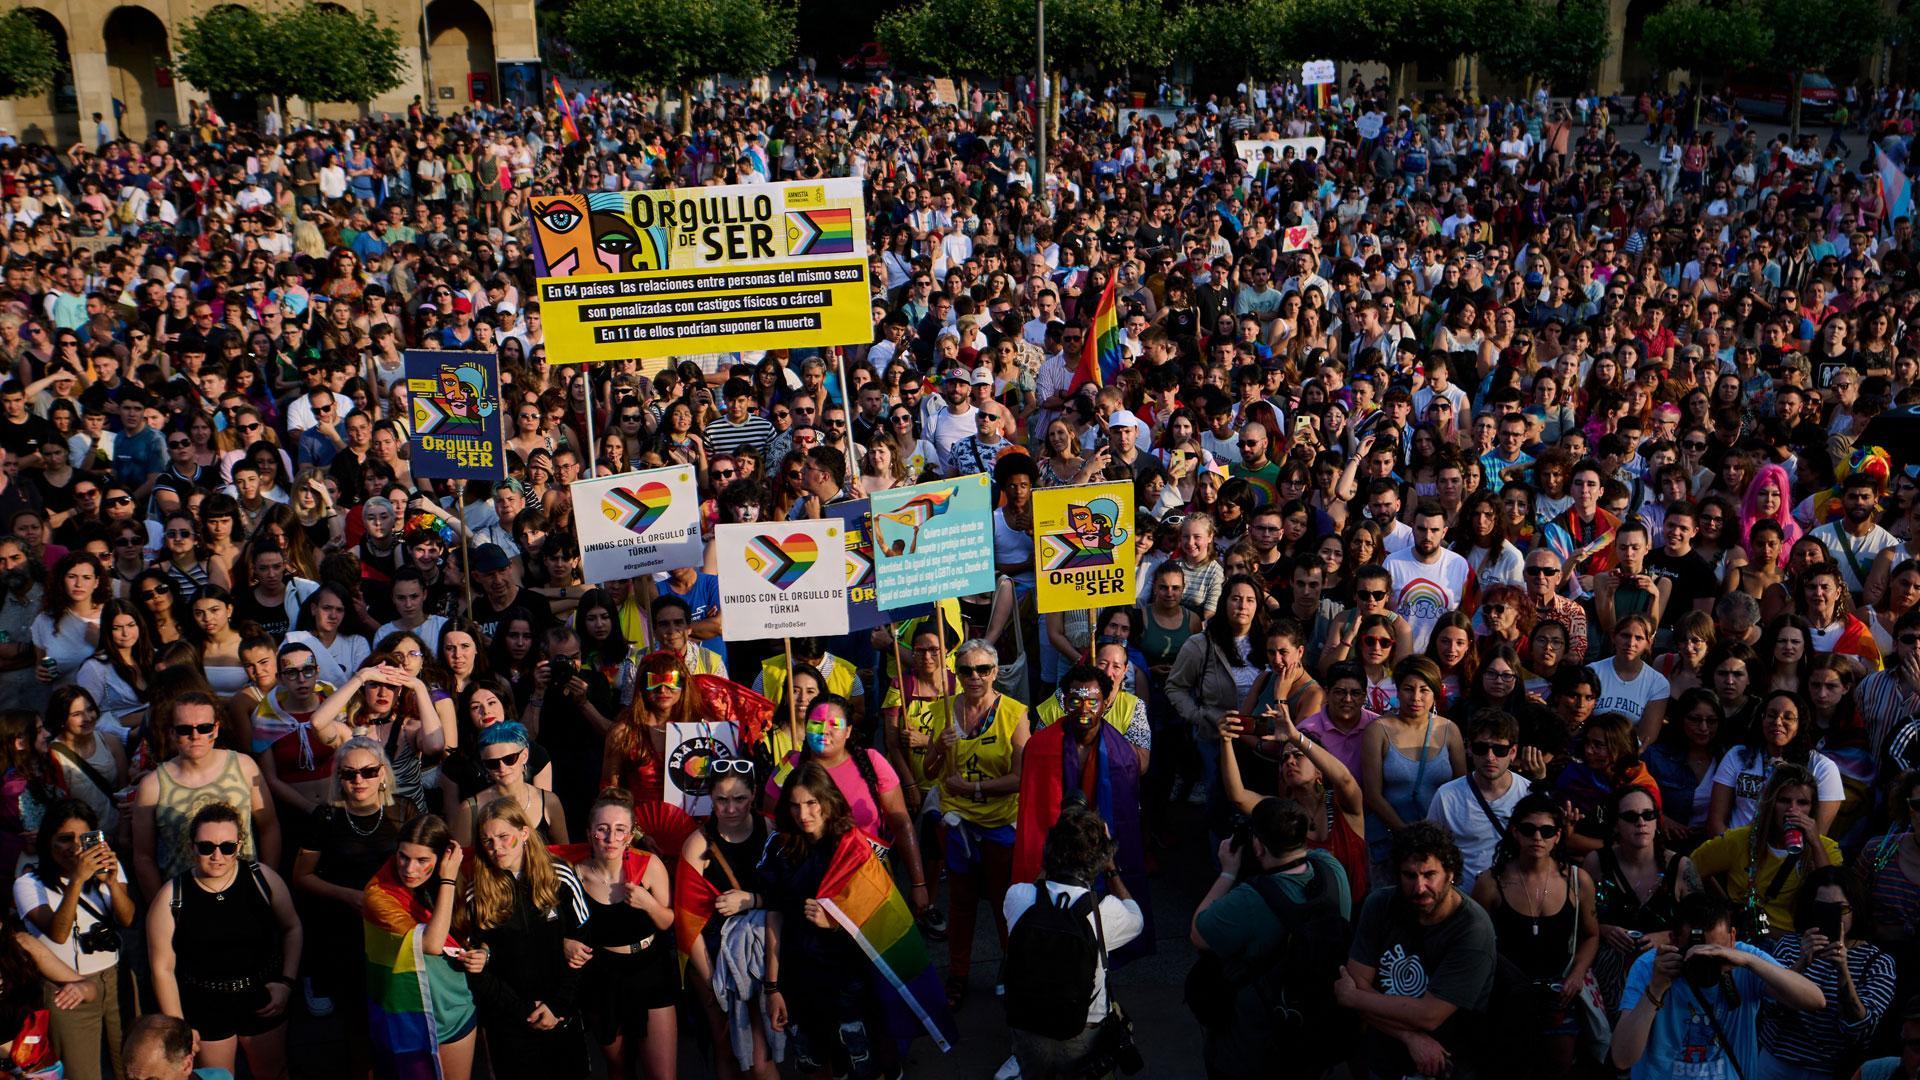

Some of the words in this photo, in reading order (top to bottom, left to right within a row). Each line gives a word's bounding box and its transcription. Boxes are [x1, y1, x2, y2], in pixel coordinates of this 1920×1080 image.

[678, 232, 697, 247] DE
[703, 223, 776, 261] SER
[548, 286, 561, 298] En
[564, 284, 578, 297] 64
[580, 283, 615, 299] países
[620, 281, 636, 293] las
[638, 278, 694, 292] relaciones
[696, 276, 724, 288] entre
[728, 274, 776, 288] personas
[778, 271, 794, 283] del
[797, 270, 832, 282] mismo
[834, 269, 858, 280] sexo
[588, 308, 606, 318] son
[610, 302, 672, 319] penalizadas
[674, 301, 694, 312] con
[697, 297, 742, 312] castigos
[743, 295, 778, 309] físicos
[780, 296, 787, 306] o
[790, 292, 824, 305] cárcel
[602, 328, 615, 340] En
[618, 327, 630, 339] 11
[633, 326, 646, 338] de
[650, 325, 674, 338] ellos
[678, 322, 717, 338] podrían
[720, 320, 762, 334] suponer
[764, 318, 774, 330] la
[776, 316, 814, 328] muerte
[456, 452, 494, 467] SER
[584, 541, 615, 552] UNIDOS
[617, 538, 634, 548] CON
[648, 530, 684, 542] ORGULLO
[687, 526, 697, 536] DE
[628, 545, 657, 556] TÜRKIA
[624, 559, 664, 570] #OrgulloDeSer
[1086, 580, 1124, 596] SER
[724, 594, 756, 604] UNIDOS
[758, 593, 776, 602] CON
[780, 592, 789, 601] EL
[791, 590, 830, 600] ORGULLO
[832, 590, 843, 598] DE
[770, 604, 800, 614] TÜRKIA
[764, 622, 806, 630] #OrgulloDeSer
[670, 744, 692, 770] BAR
